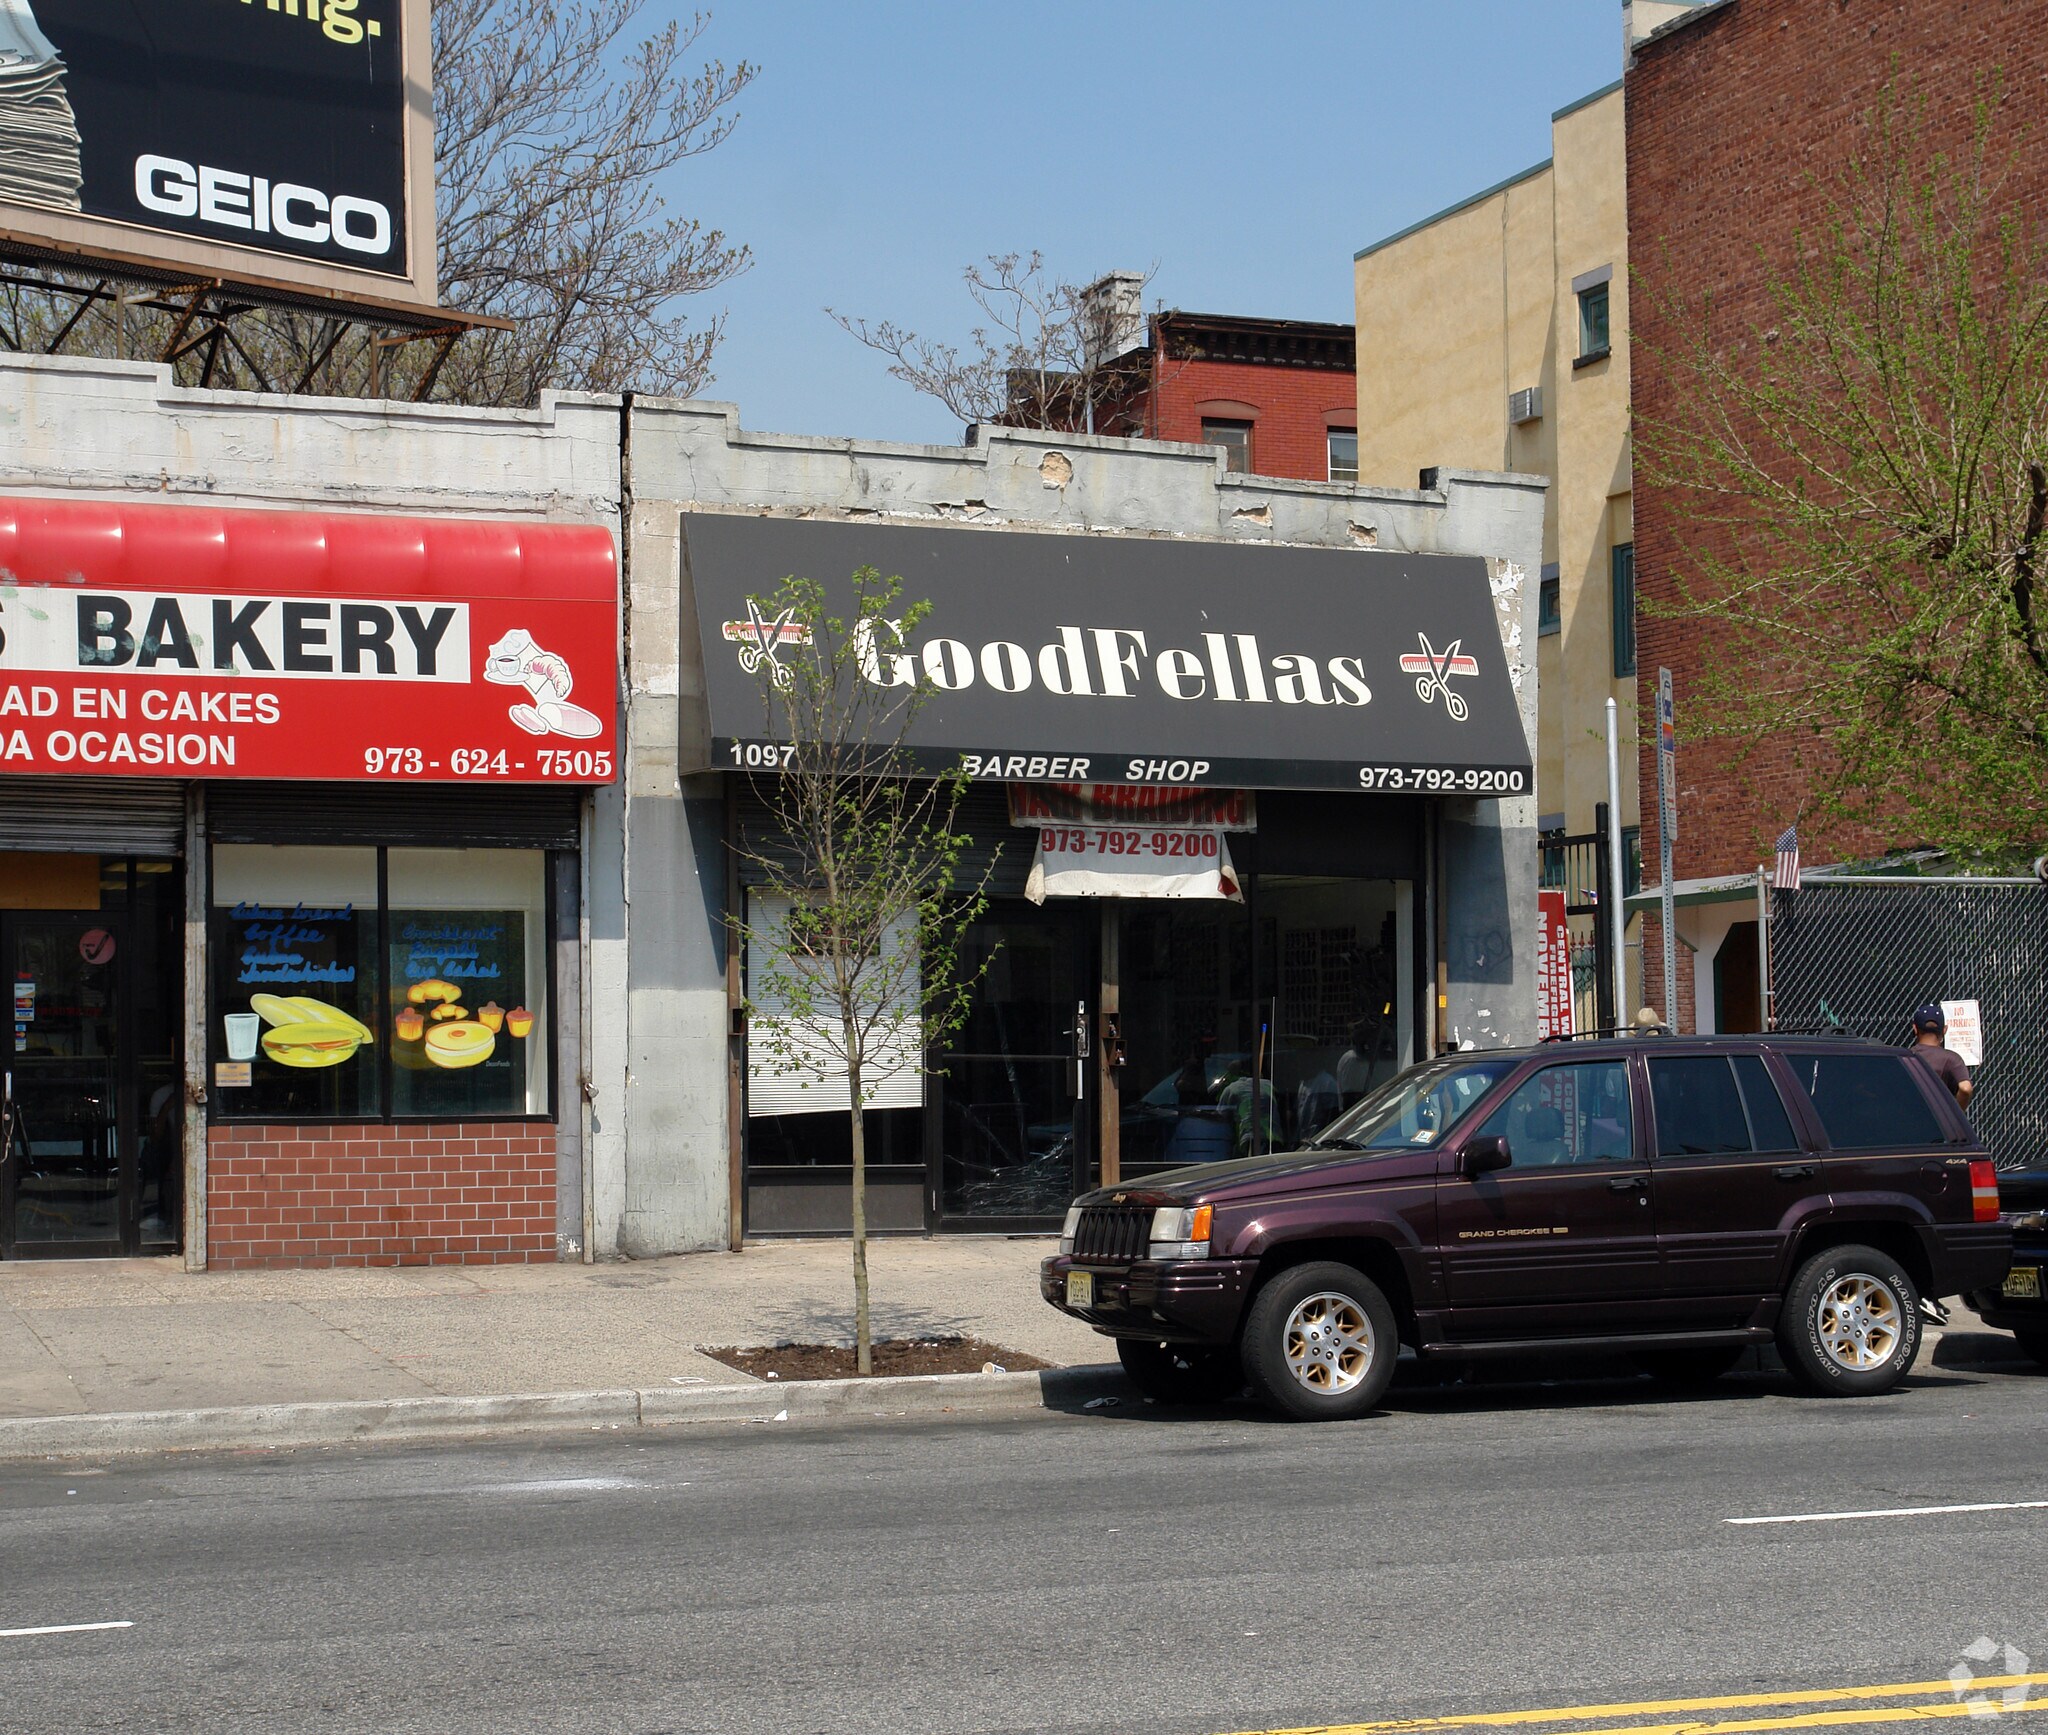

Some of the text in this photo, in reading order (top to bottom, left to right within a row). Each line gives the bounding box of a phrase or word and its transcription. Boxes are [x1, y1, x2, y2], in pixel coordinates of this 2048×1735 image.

[135, 154, 391, 255] GEICO
[77, 594, 457, 676] BAKERY
[852, 616, 1373, 707] GoodFellas
[72, 687, 127, 720] EN
[140, 689, 281, 724] CAKES
[0, 729, 236, 766] A OCASION
[730, 742, 796, 768] 1097
[964, 756, 1210, 782] BARBER SHOP
[1359, 767, 1524, 791] 973-792-9200
[1092, 784, 1249, 825] BRAIDING
[1041, 829, 1218, 858] 973-792-9200
[1538, 911, 1551, 1042] NOVEMB
[1556, 924, 1571, 1036] CENTRAL W
[1954, 1006, 1965, 1016] NO
[1458, 1230, 1495, 1239] GRAND
[1496, 1227, 1550, 1237] CHEROKEE
